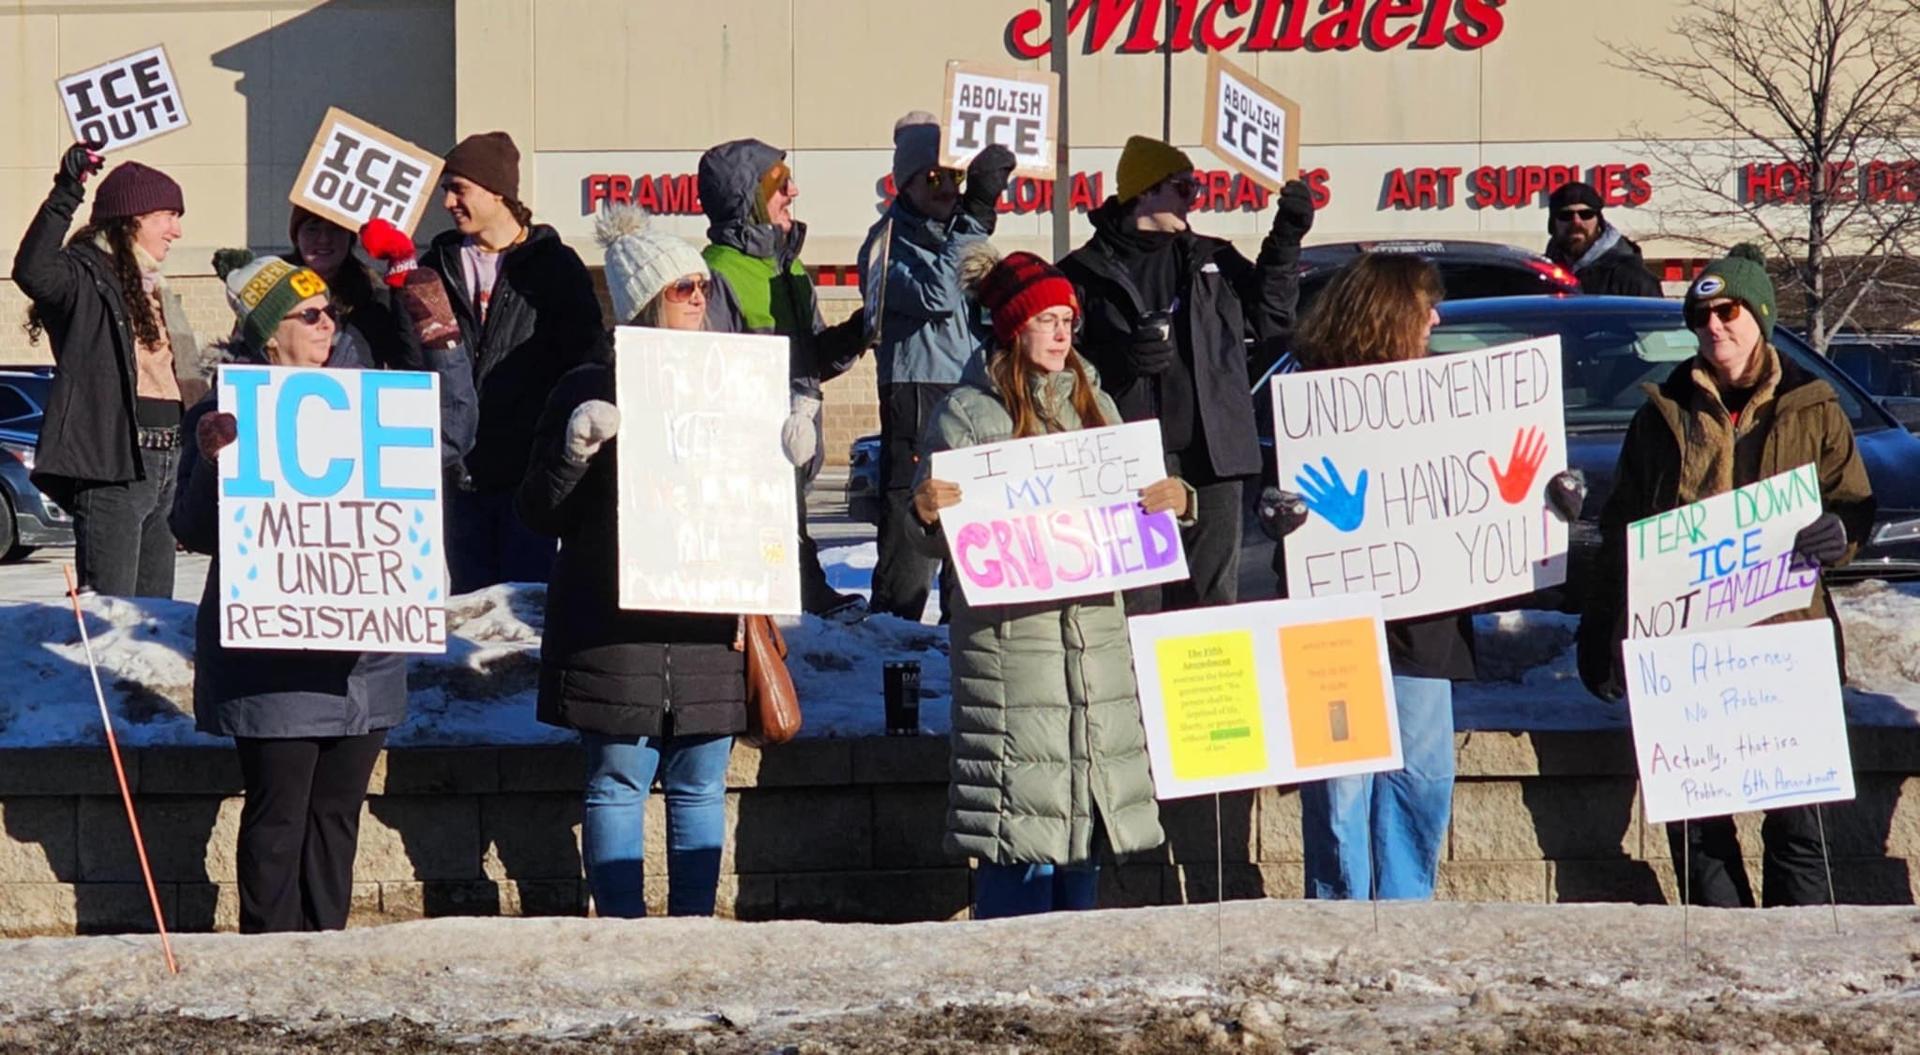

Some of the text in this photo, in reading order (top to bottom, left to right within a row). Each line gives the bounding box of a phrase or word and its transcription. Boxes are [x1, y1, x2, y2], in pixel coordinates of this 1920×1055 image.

[65, 56, 169, 122] ICE
[959, 83, 1042, 117] ABOLISH
[1224, 83, 1280, 136] ABOLISH
[80, 95, 179, 151] OUT!
[956, 110, 1041, 156] ICE
[1222, 106, 1279, 173] ICE
[323, 131, 423, 204] ICE
[1384, 166, 1462, 209] ART
[1278, 347, 1550, 440] UNDOCUMENTED
[222, 369, 436, 500] ICE
[973, 432, 1122, 480] I LIKE
[1004, 457, 1144, 510] MY ICE
[1380, 450, 1490, 528] HANDS
[257, 501, 403, 549] MELTS
[1629, 465, 1819, 560] TEAR DOWN
[277, 550, 407, 596] UNDER
[1687, 528, 1763, 587] ICE
[226, 603, 446, 645] RESISTANCE
[1631, 588, 1701, 640] NOT
[1639, 651, 1672, 696] No
[1683, 702, 1709, 724] No
[1651, 741, 1729, 774] Actually,
[1735, 733, 1769, 761] that
[1741, 767, 1769, 797] 6th
